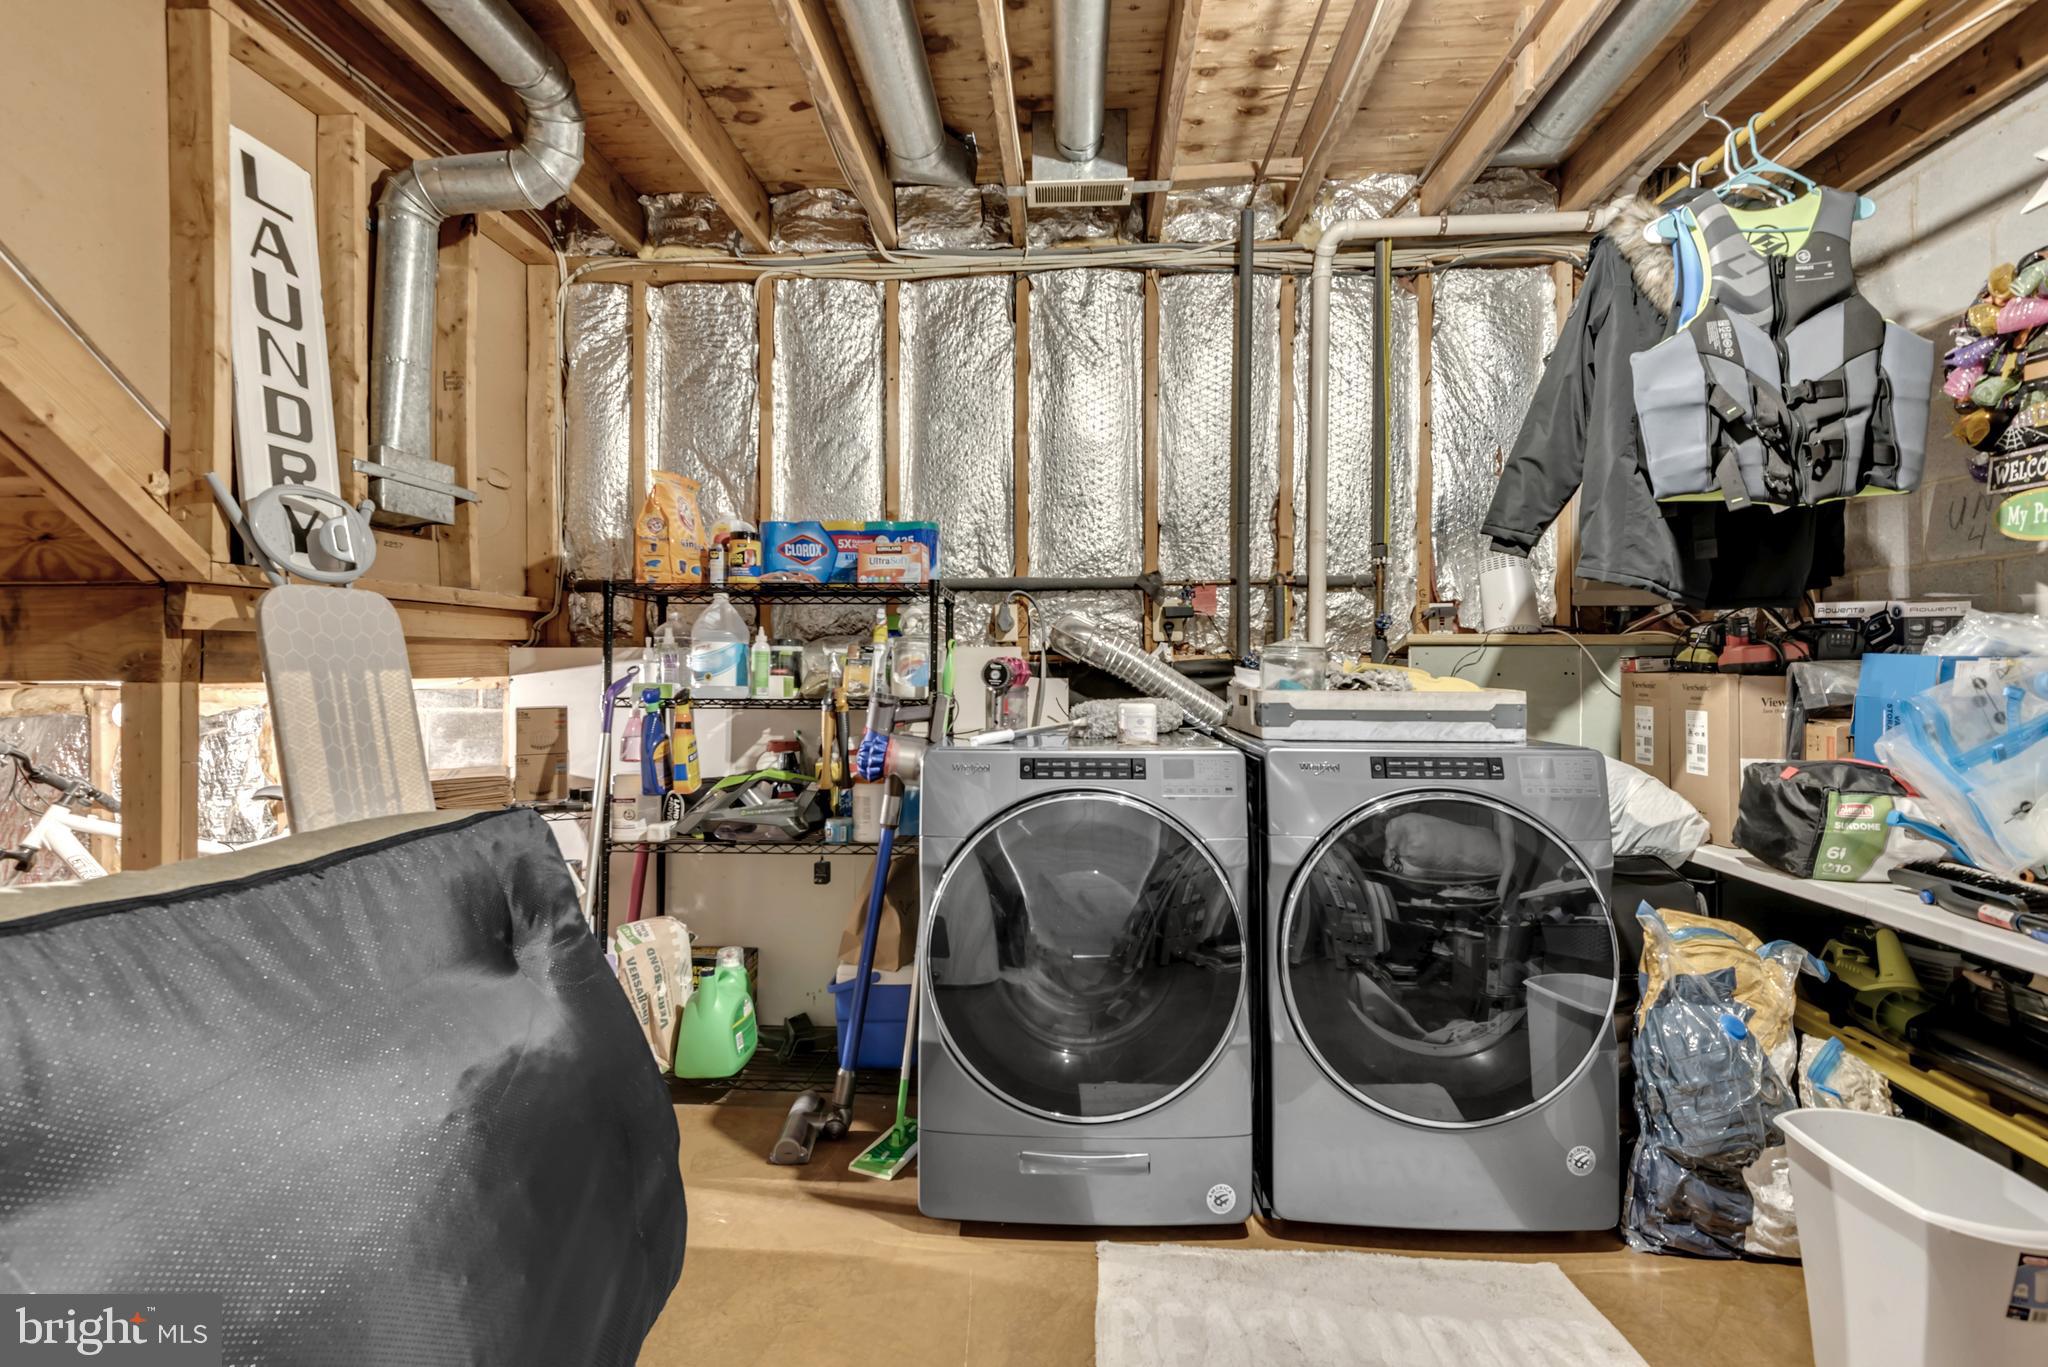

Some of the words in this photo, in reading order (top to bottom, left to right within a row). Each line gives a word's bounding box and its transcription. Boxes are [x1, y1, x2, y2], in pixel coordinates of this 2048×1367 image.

[240, 148, 320, 555] LAUNDRY
[2007, 504, 2029, 532] My
[784, 543, 823, 558] CLOROX
